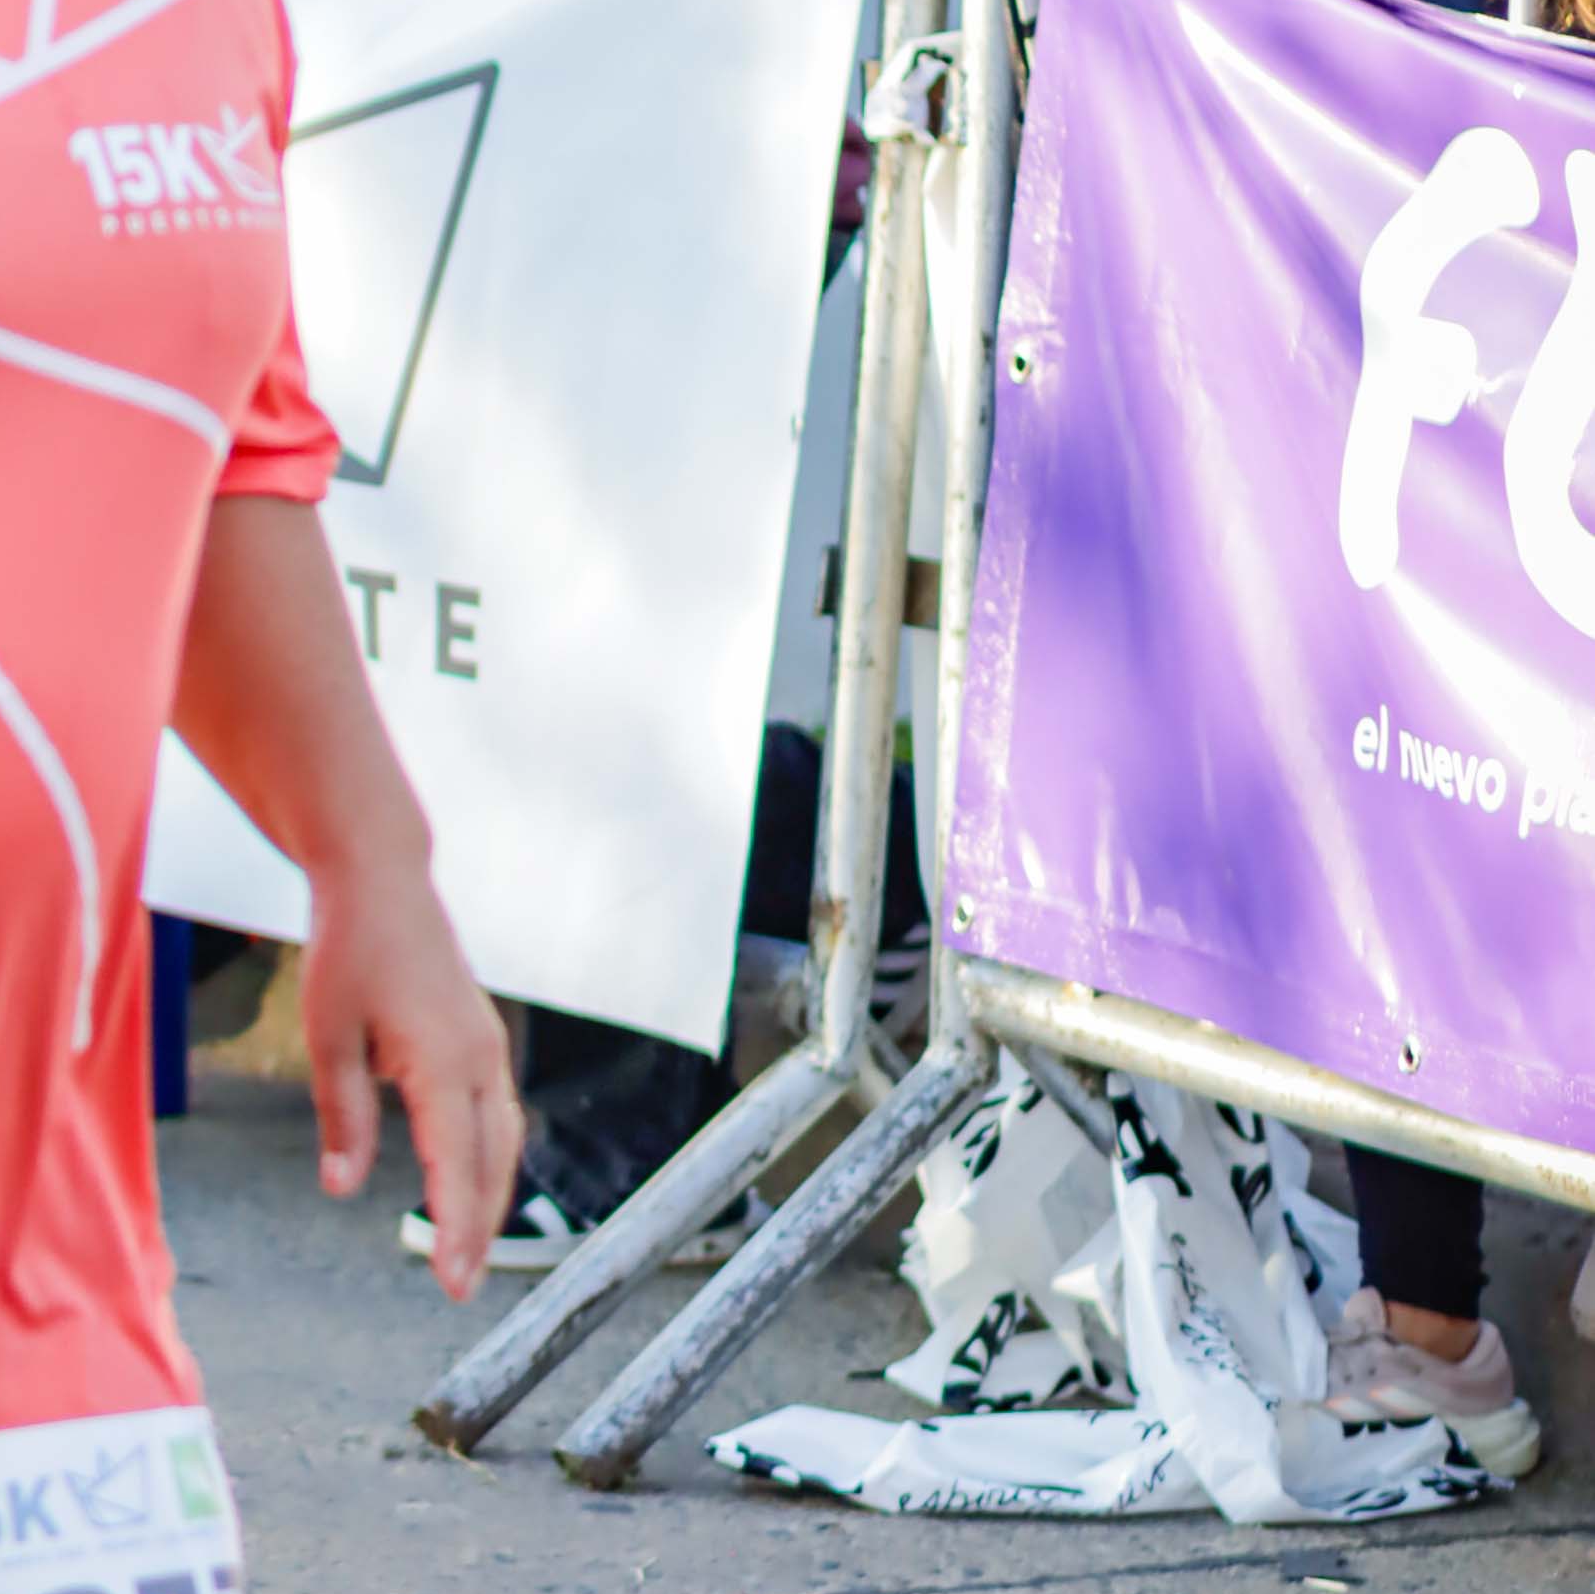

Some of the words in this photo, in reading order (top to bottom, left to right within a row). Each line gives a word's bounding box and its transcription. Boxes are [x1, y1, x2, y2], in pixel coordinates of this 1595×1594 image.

[69, 121, 220, 210] 15K
[1353, 703, 1389, 773] el
[1398, 728, 1507, 814] nuevo
